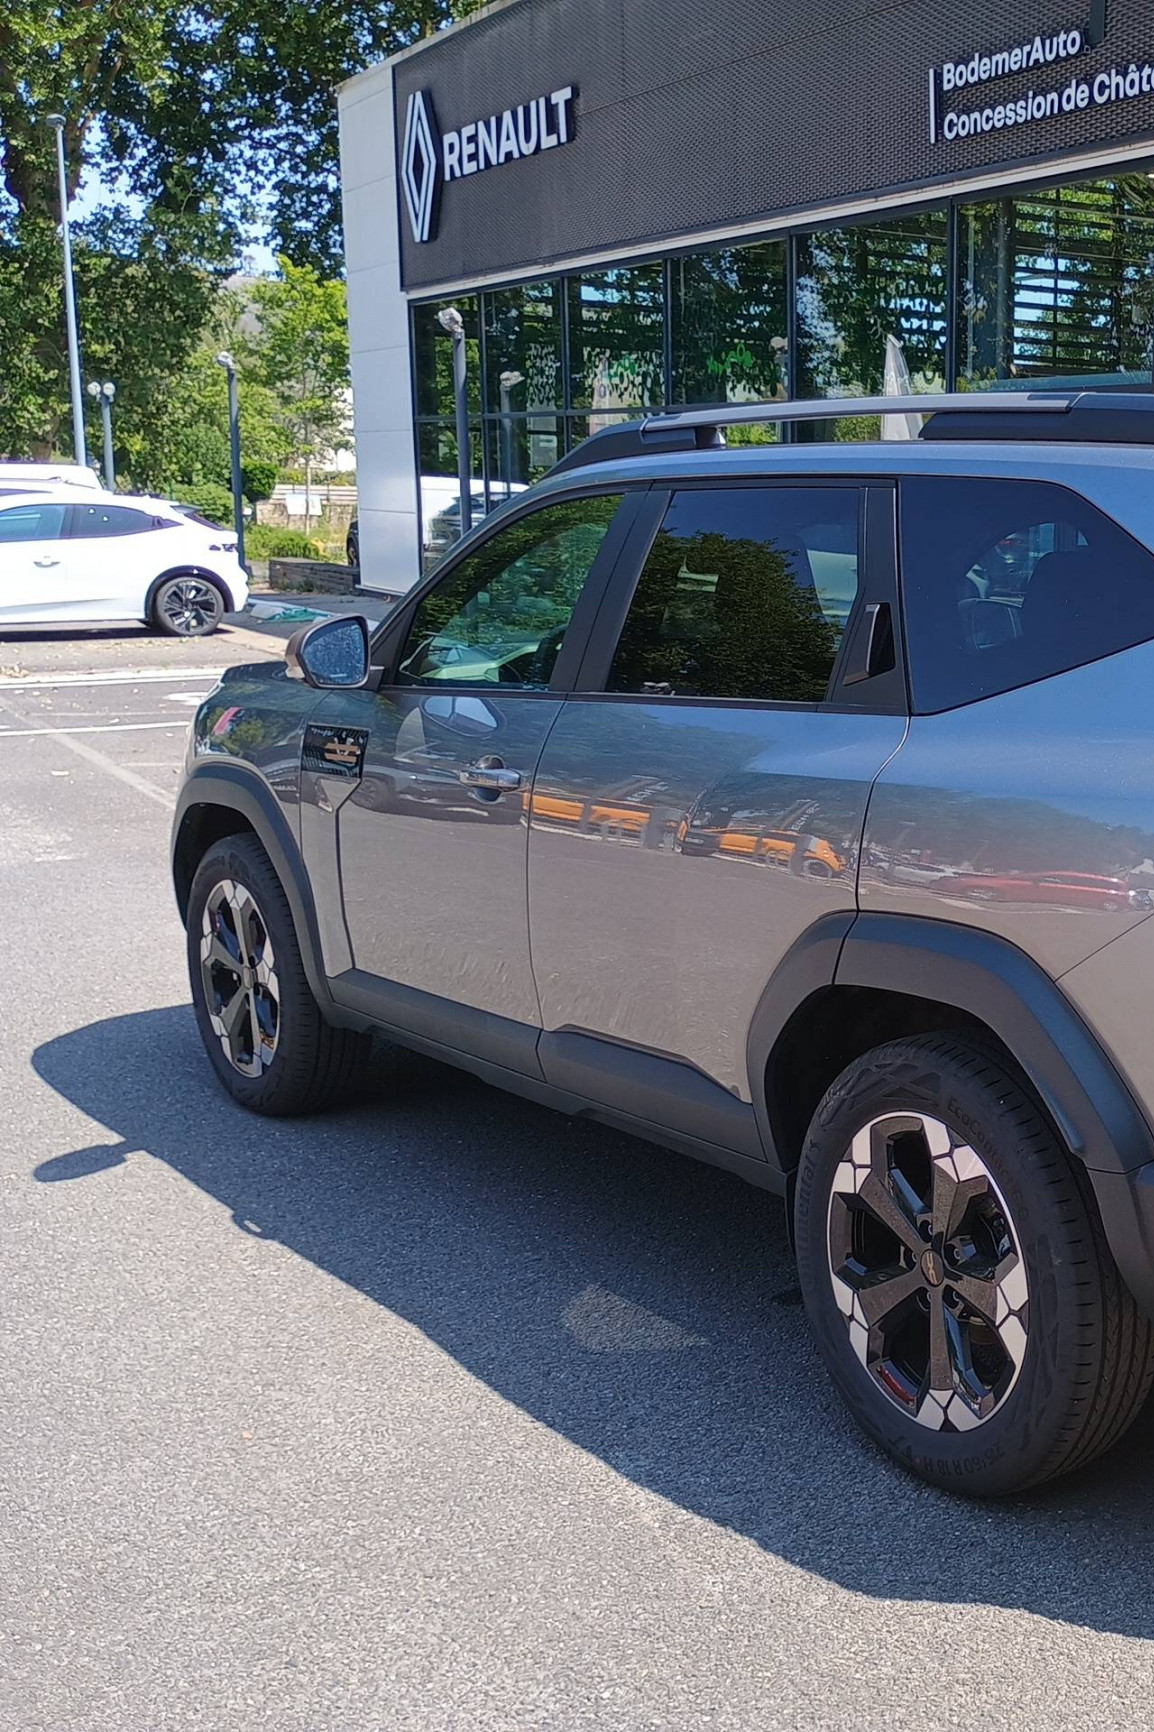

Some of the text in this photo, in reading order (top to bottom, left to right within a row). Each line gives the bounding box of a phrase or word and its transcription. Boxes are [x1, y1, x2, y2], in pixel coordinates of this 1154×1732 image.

[942, 30, 1081, 91] BodemerAuto
[442, 86, 572, 182] RENAULT
[943, 91, 1059, 140] Concession
[1062, 79, 1089, 112] de
